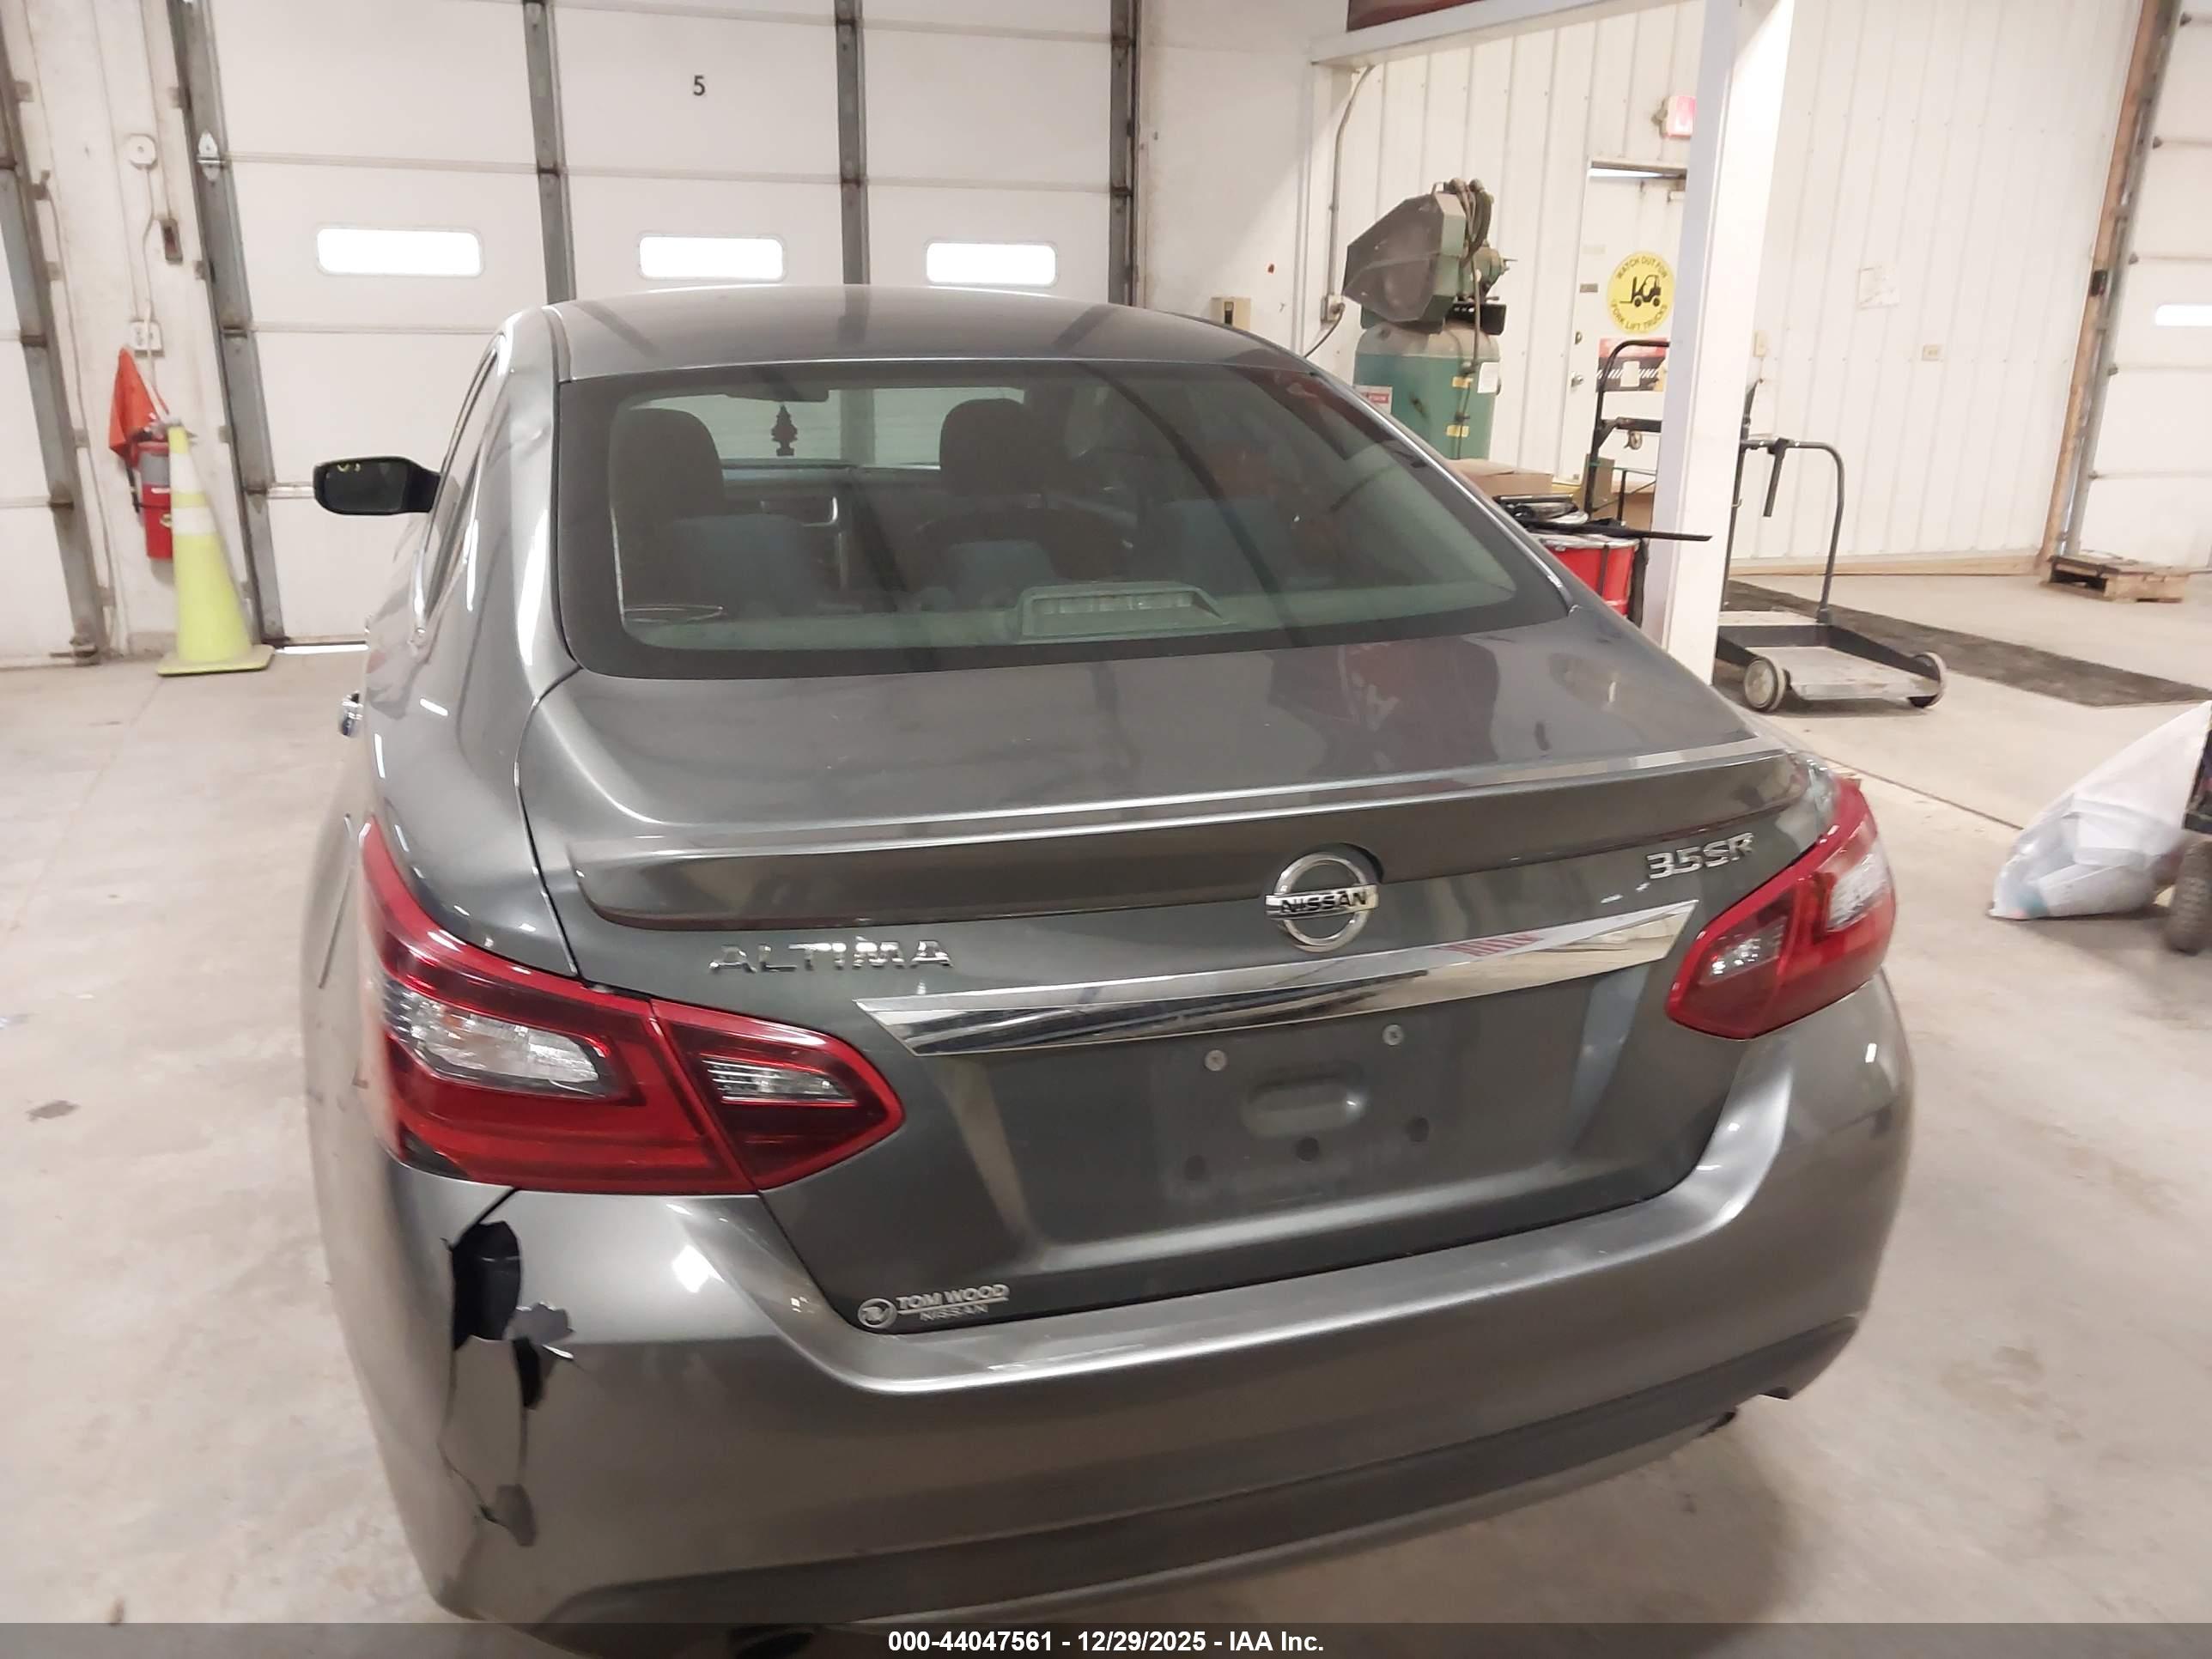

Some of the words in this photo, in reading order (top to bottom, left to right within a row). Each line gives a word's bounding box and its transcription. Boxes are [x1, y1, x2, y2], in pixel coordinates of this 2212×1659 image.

[693, 75, 706, 96] 5
[1280, 890, 1367, 913] NISSAN
[708, 939, 954, 973] ALTIMA
[896, 1291, 944, 1310] TOM
[944, 1283, 1011, 1304] WOOD
[920, 1304, 988, 1322] NISSAN
